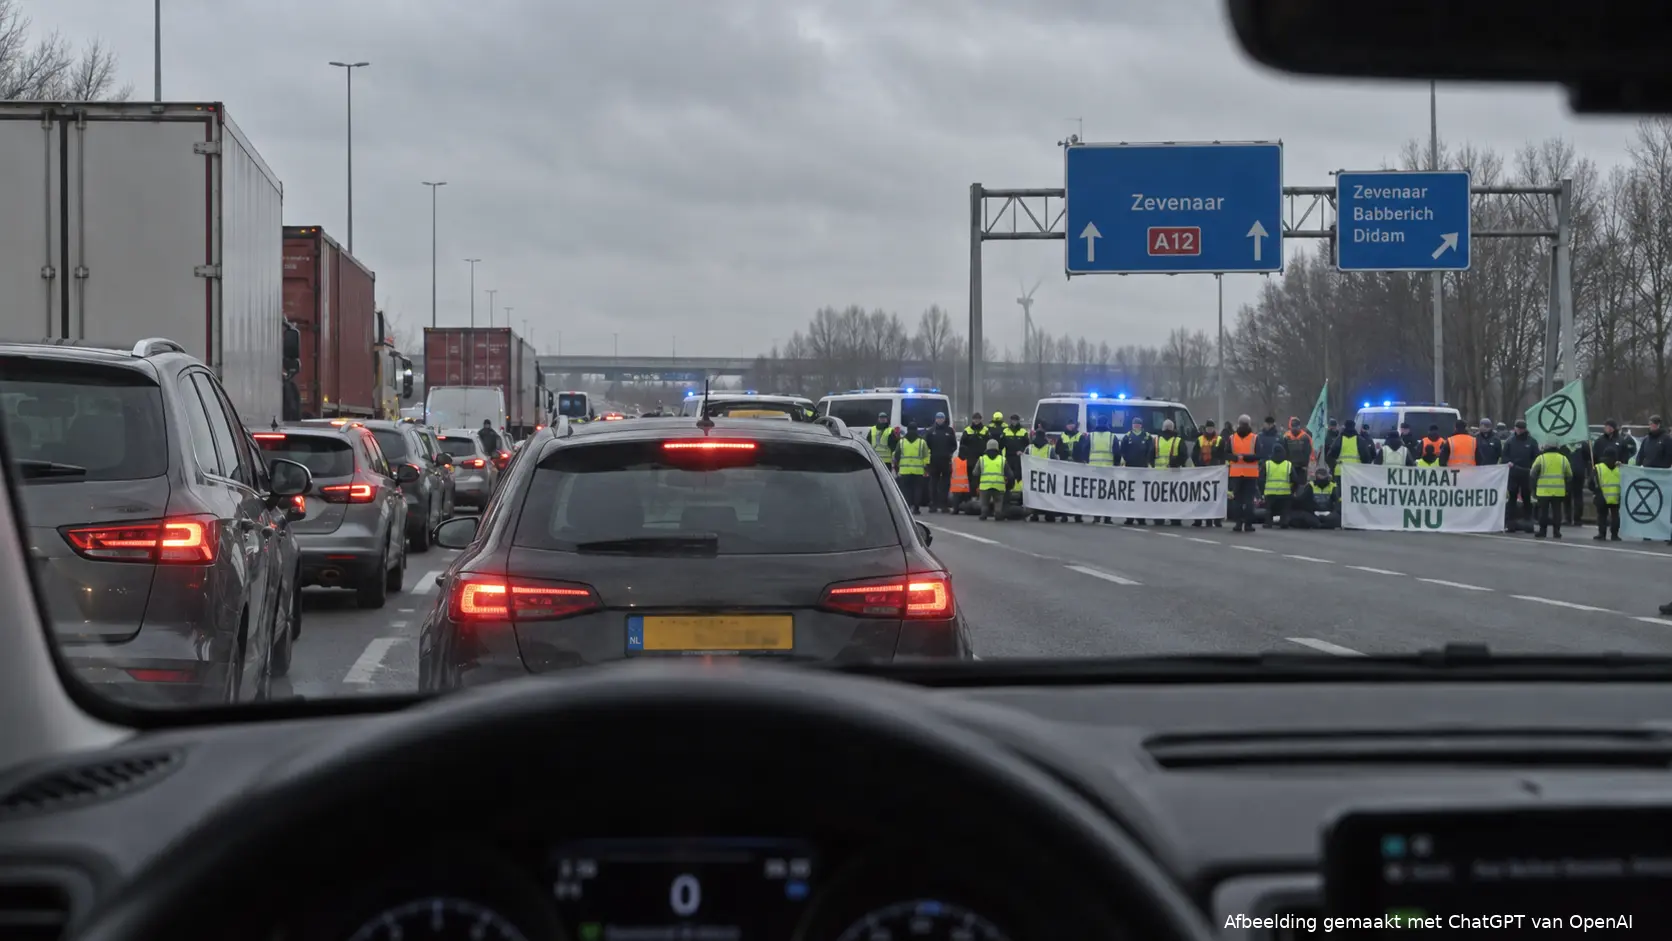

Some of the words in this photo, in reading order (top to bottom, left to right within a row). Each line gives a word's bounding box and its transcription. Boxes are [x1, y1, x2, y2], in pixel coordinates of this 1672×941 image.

[1353, 184, 1429, 199] Zevenaar
[1131, 193, 1225, 211] Zevenaar
[1353, 206, 1434, 221] Babberich
[1154, 232, 1195, 250] A12
[1353, 228, 1405, 243] Didam
[1029, 469, 1057, 495] EEN
[1063, 474, 1136, 502] LEEFBARE
[1142, 477, 1222, 503] TOEKOMST
[1387, 466, 1461, 488] KLIMAAT
[1350, 486, 1499, 508] RECHTVAARDIGHEID
[1403, 508, 1443, 529] NU
[629, 636, 641, 645] NL
[669, 874, 701, 916] 0
